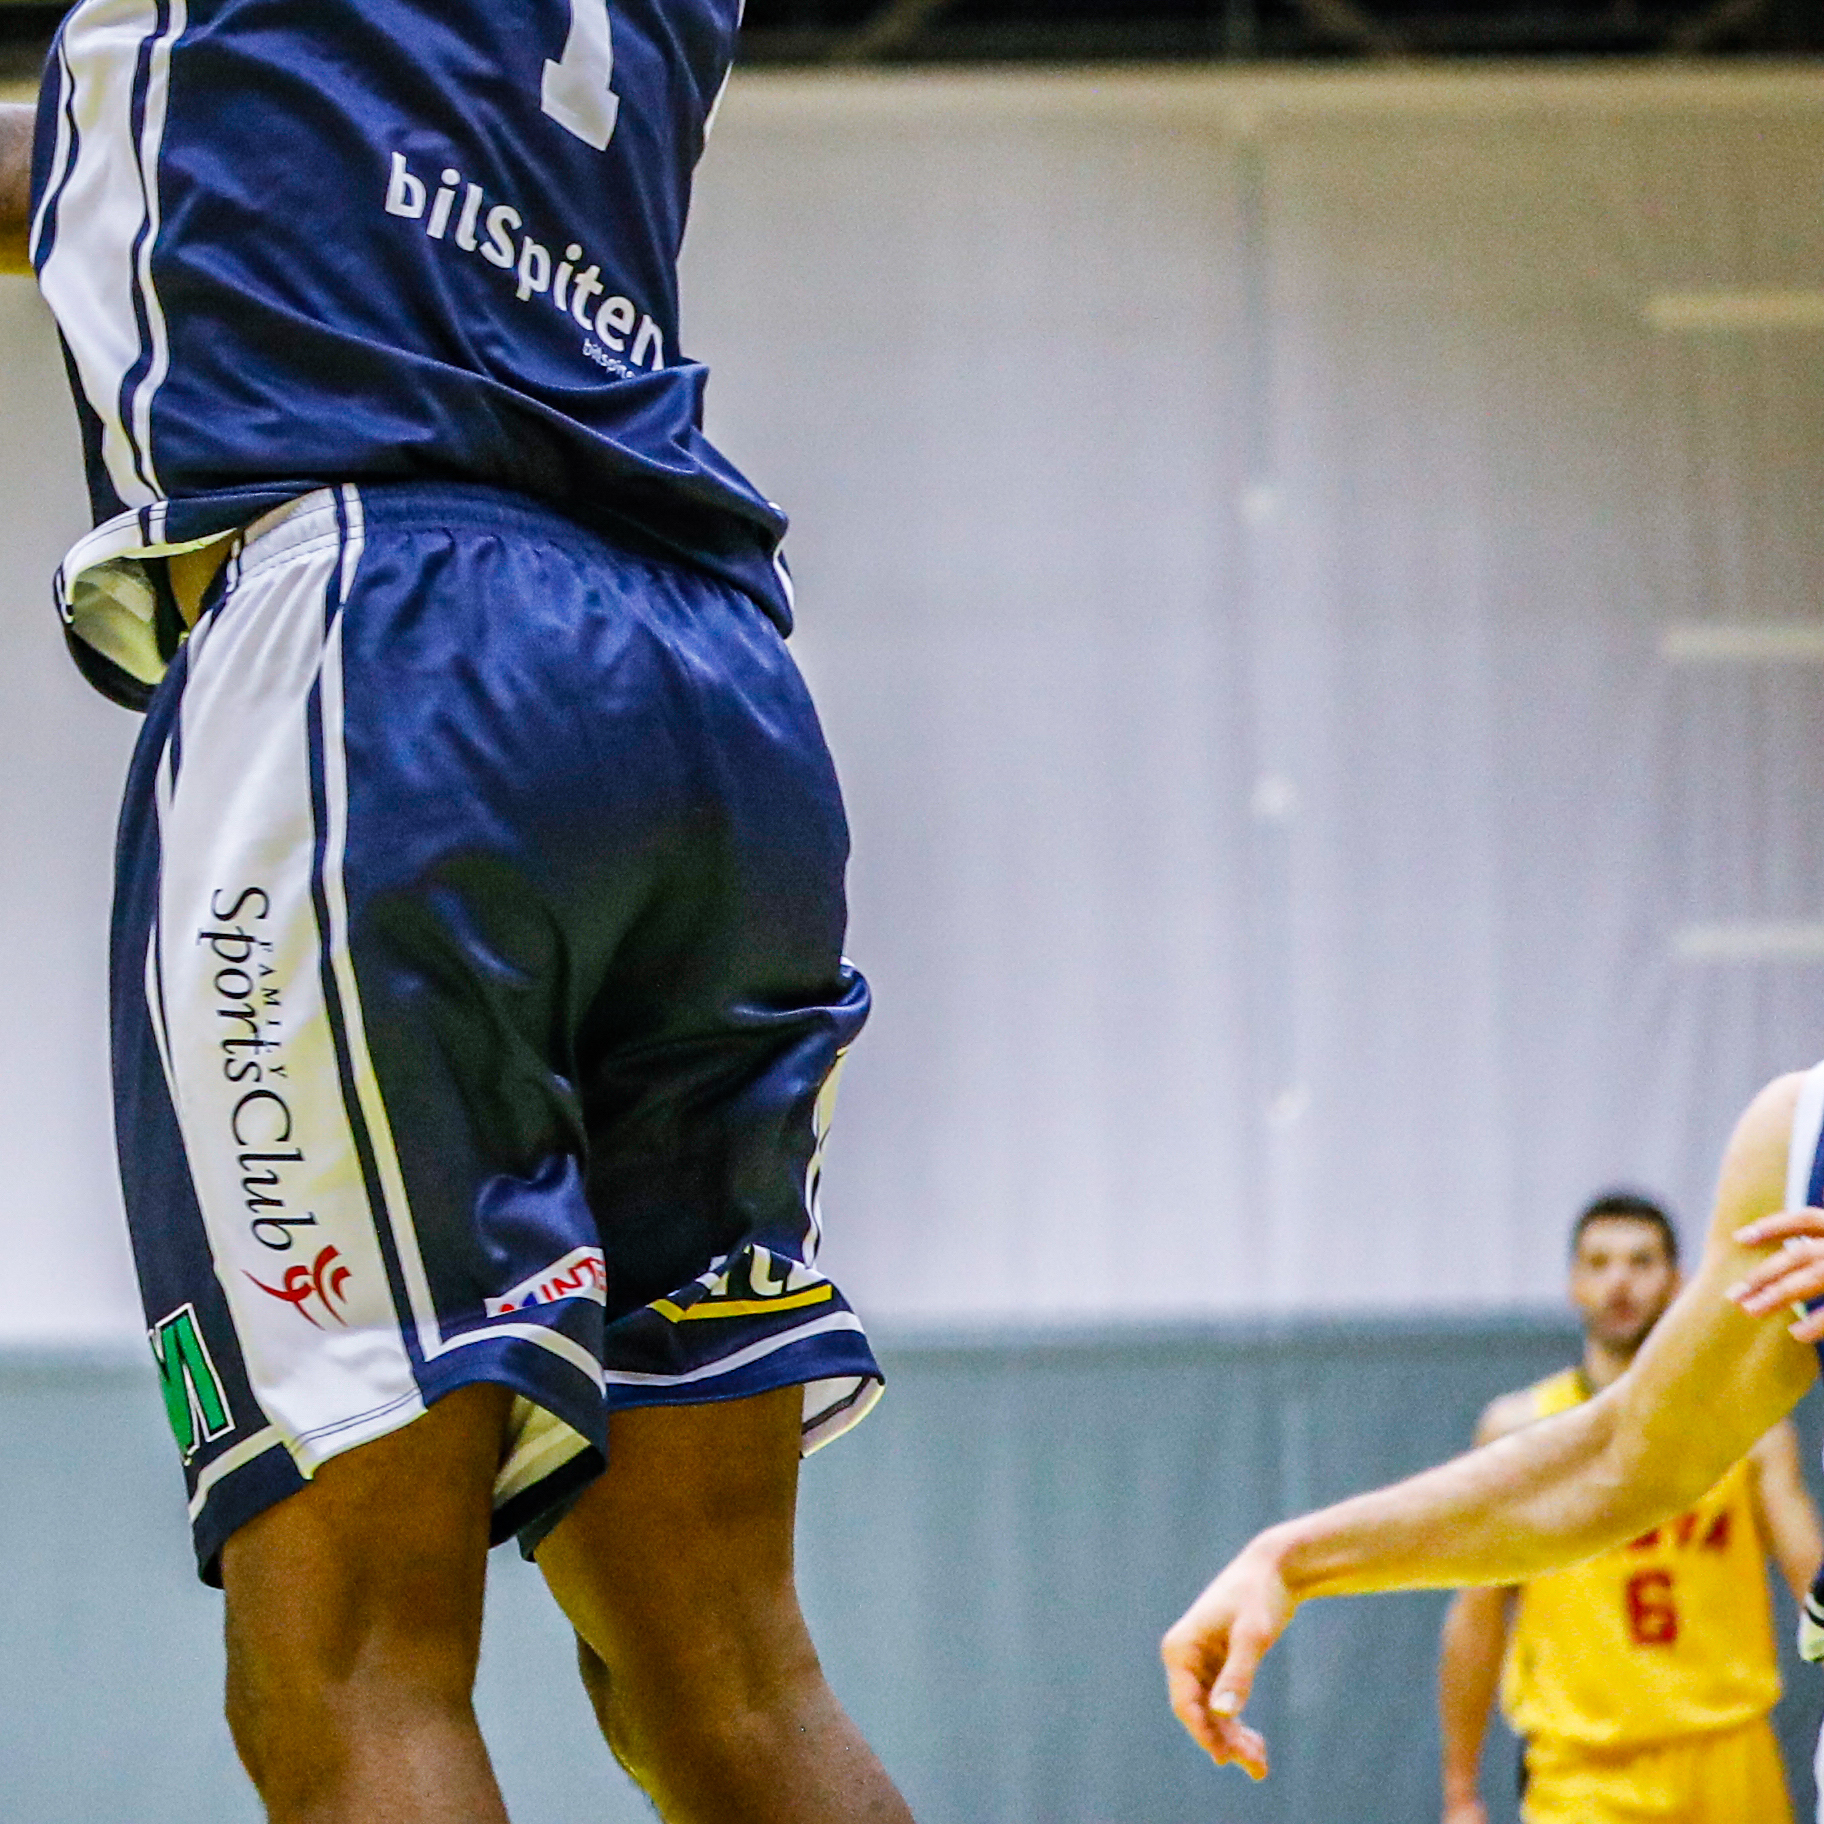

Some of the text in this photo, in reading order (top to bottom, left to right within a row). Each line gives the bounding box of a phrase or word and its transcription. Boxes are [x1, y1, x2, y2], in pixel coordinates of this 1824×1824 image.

[384, 150, 665, 372] bilSpiten
[197, 886, 319, 1253] SportsClub
[258, 939, 288, 1079] FAMILY
[1625, 1567, 1680, 1646] 6
